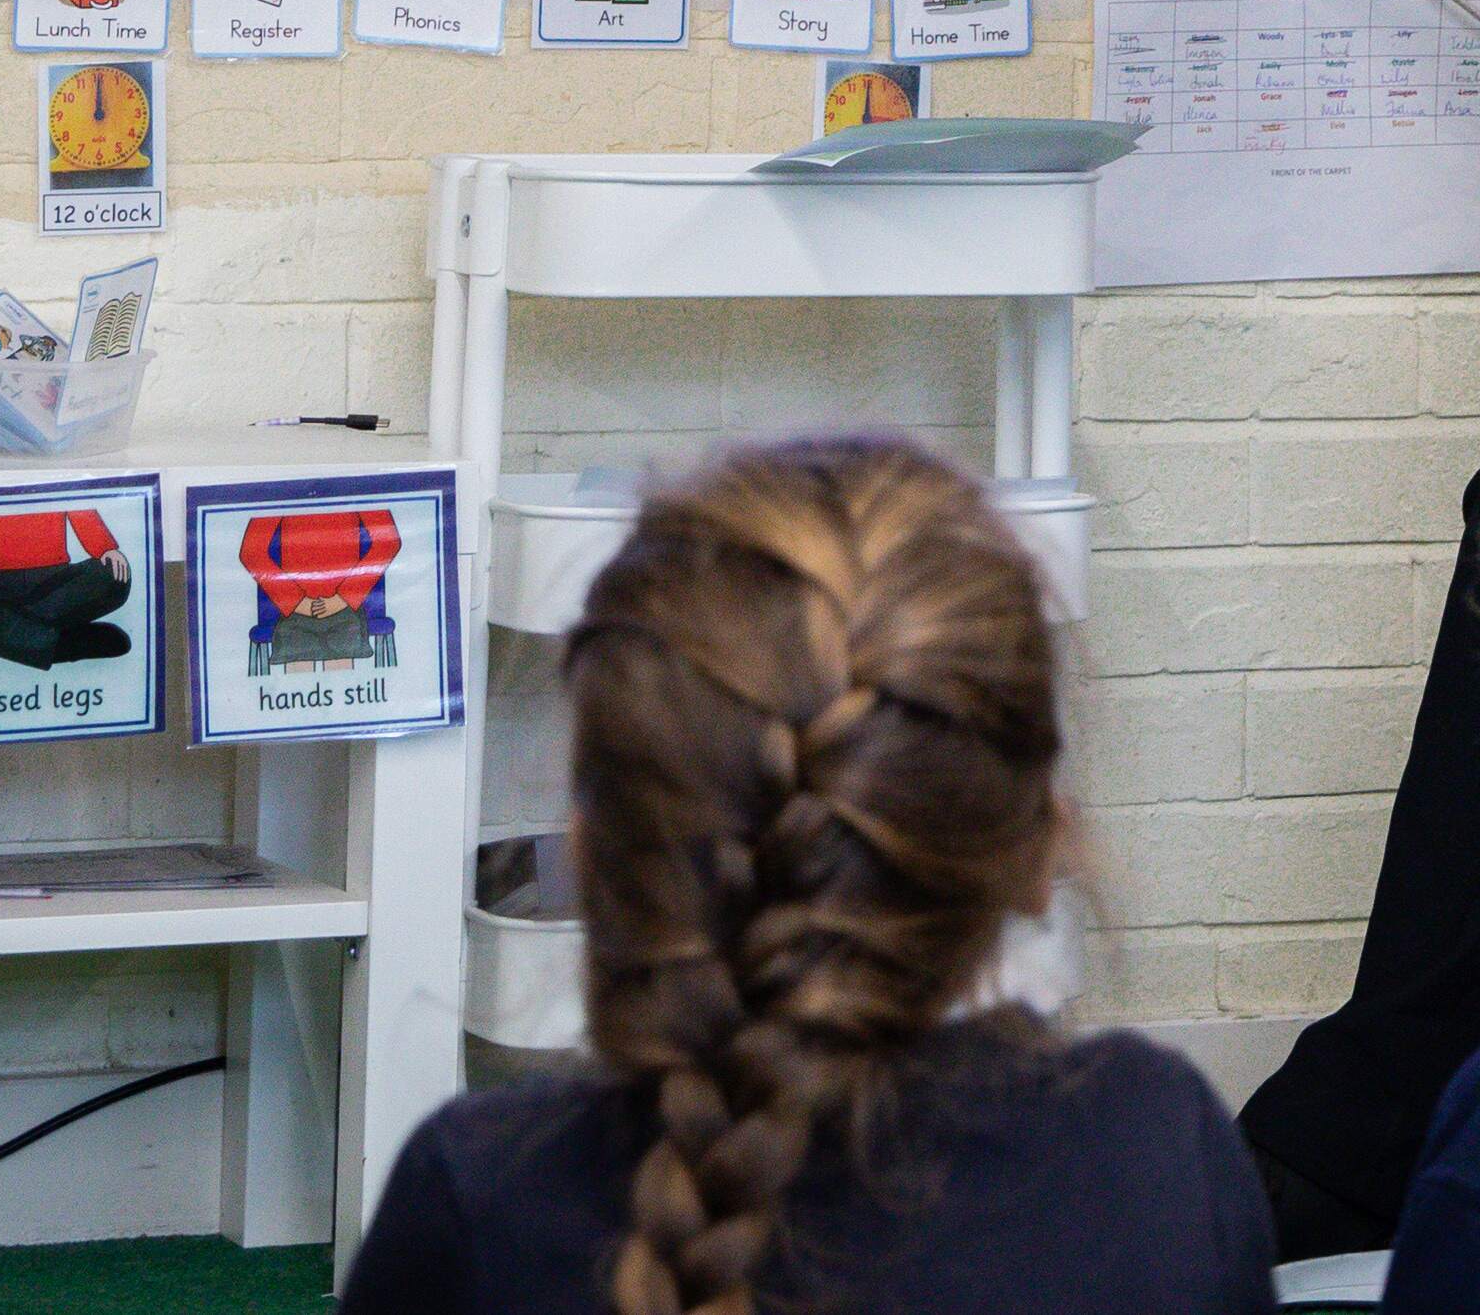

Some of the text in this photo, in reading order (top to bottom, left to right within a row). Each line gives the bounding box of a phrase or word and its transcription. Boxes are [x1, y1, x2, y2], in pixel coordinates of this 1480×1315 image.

[35, 16, 148, 40] Lunch Time
[393, 6, 461, 33] Phonics
[598, 9, 624, 27] Art
[778, 9, 829, 42] Story
[230, 18, 302, 48] Register
[911, 23, 1010, 45] Home Time
[54, 202, 152, 224] 12 o'clock
[53, 682, 103, 717] legs
[259, 677, 388, 711] hands still
